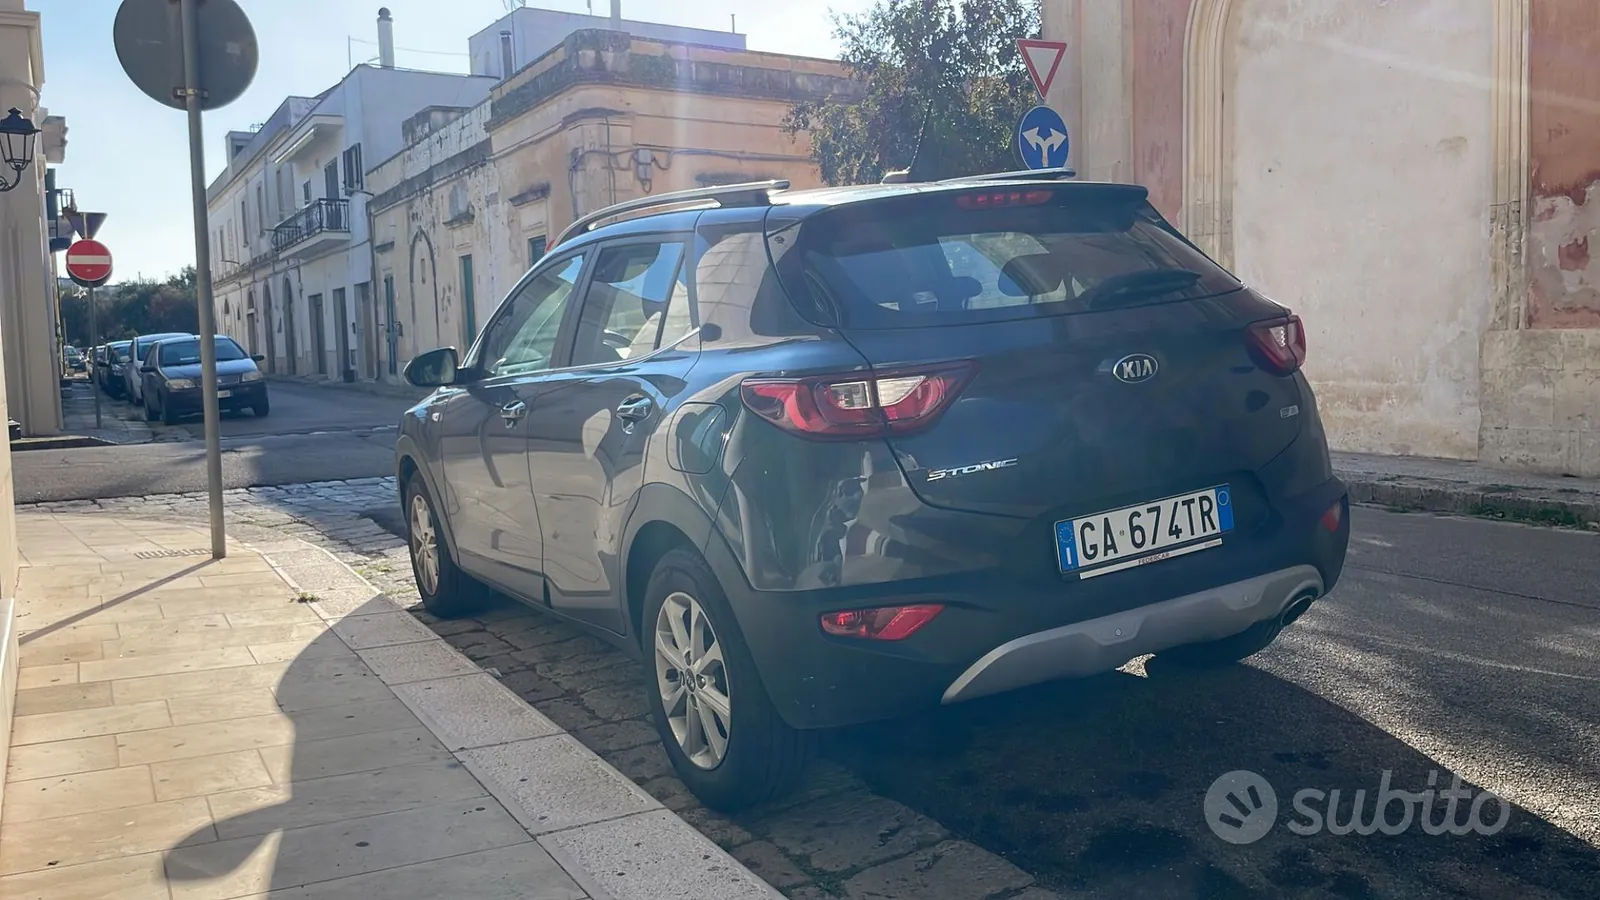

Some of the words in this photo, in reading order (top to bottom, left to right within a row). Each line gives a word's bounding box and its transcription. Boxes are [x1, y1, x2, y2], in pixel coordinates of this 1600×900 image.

[1121, 359, 1153, 379] KIA
[926, 458, 1018, 482] STONIC
[1079, 517, 1119, 561] GA
[1128, 495, 1217, 549] 674TR
